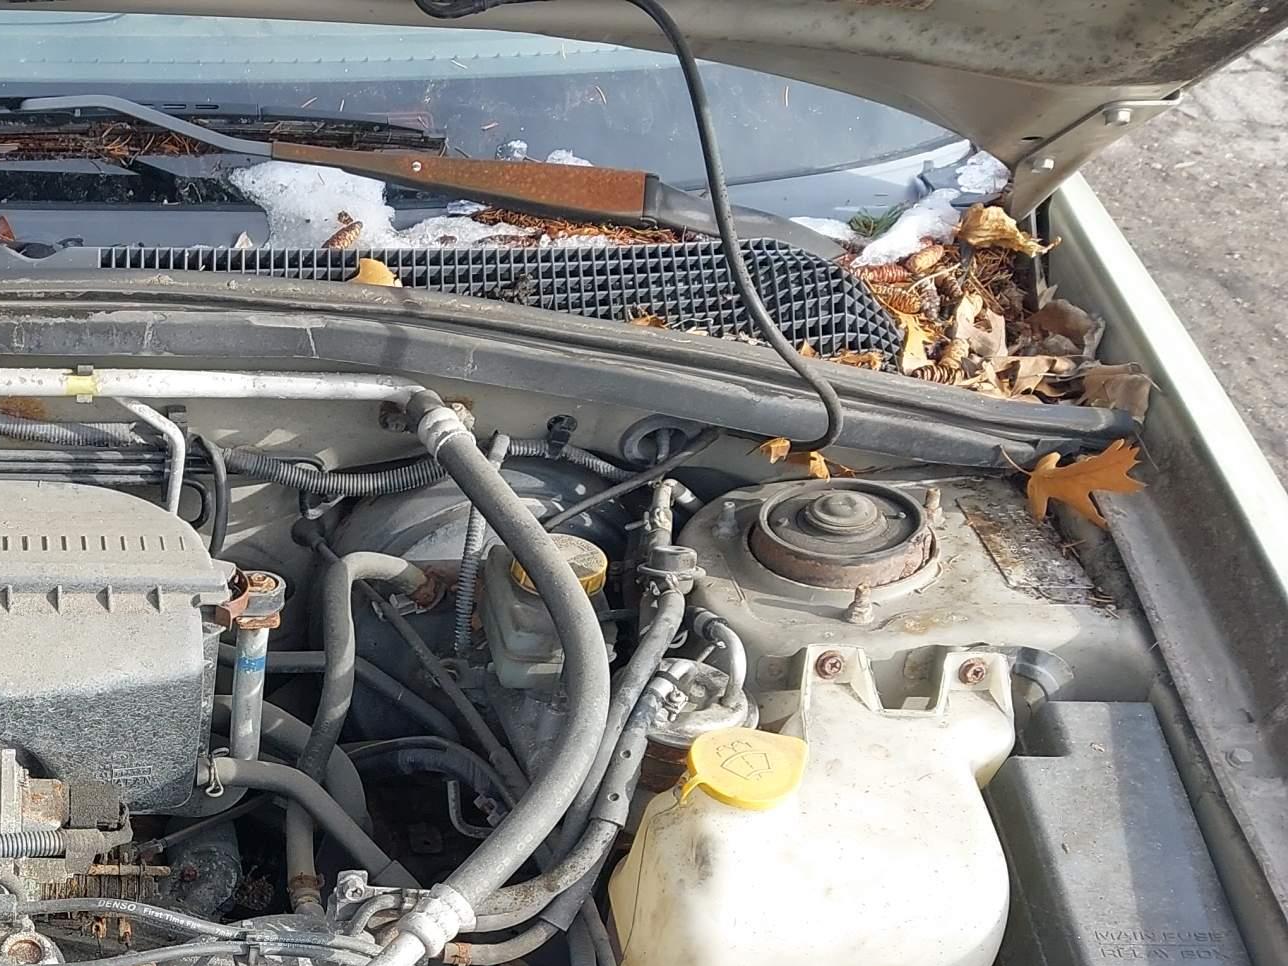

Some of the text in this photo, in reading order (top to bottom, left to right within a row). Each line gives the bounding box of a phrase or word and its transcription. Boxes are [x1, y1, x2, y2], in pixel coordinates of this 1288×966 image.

[97, 900, 137, 912] DENSO
[143, 907, 163, 919] First
[163, 914, 185, 925] Time
[1095, 930, 1225, 942] MAIN FUSE
[1100, 947, 1232, 960] RELAY BOX
